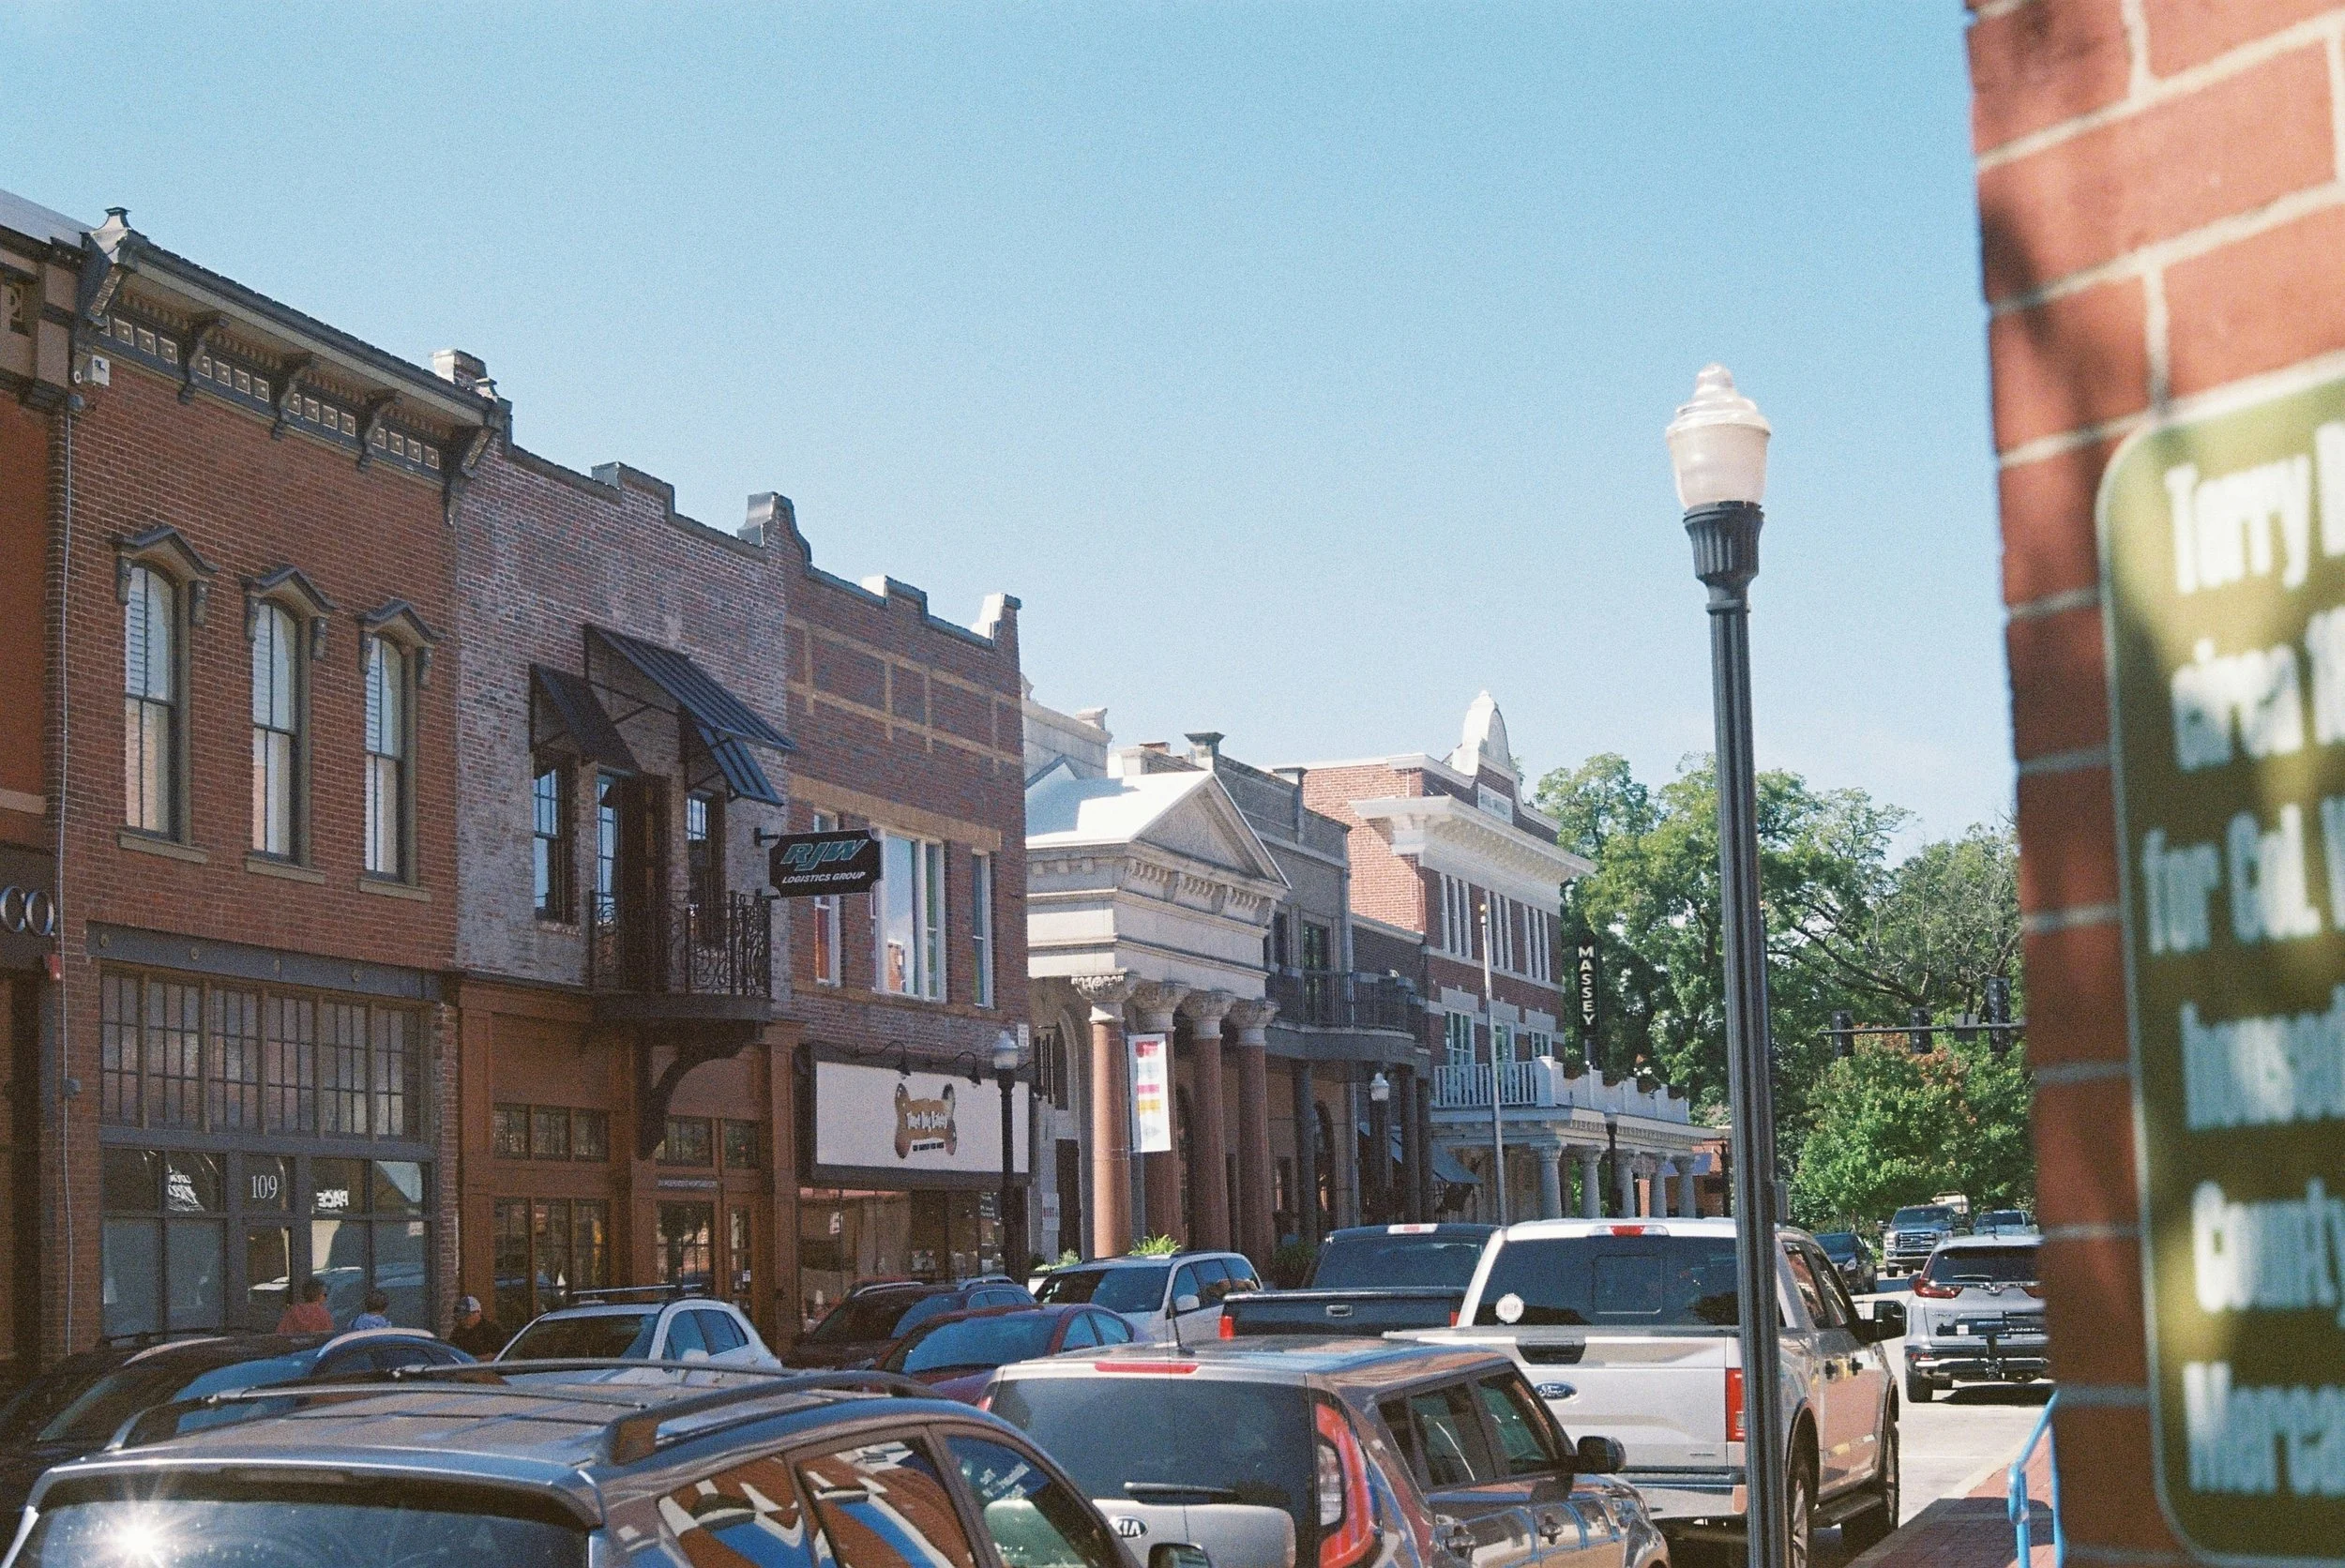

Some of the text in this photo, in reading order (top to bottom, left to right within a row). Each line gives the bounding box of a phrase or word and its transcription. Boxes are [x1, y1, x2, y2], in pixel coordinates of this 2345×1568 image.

[2165, 454, 2310, 594] Terry
[780, 839, 869, 872] RJW
[782, 871, 866, 883] LOGISTICS GROUP
[2143, 829, 2219, 953] for
[1578, 946, 1596, 1025] MASSEY
[251, 1175, 278, 1199] 109
[1115, 1519, 1141, 1536] KIA
